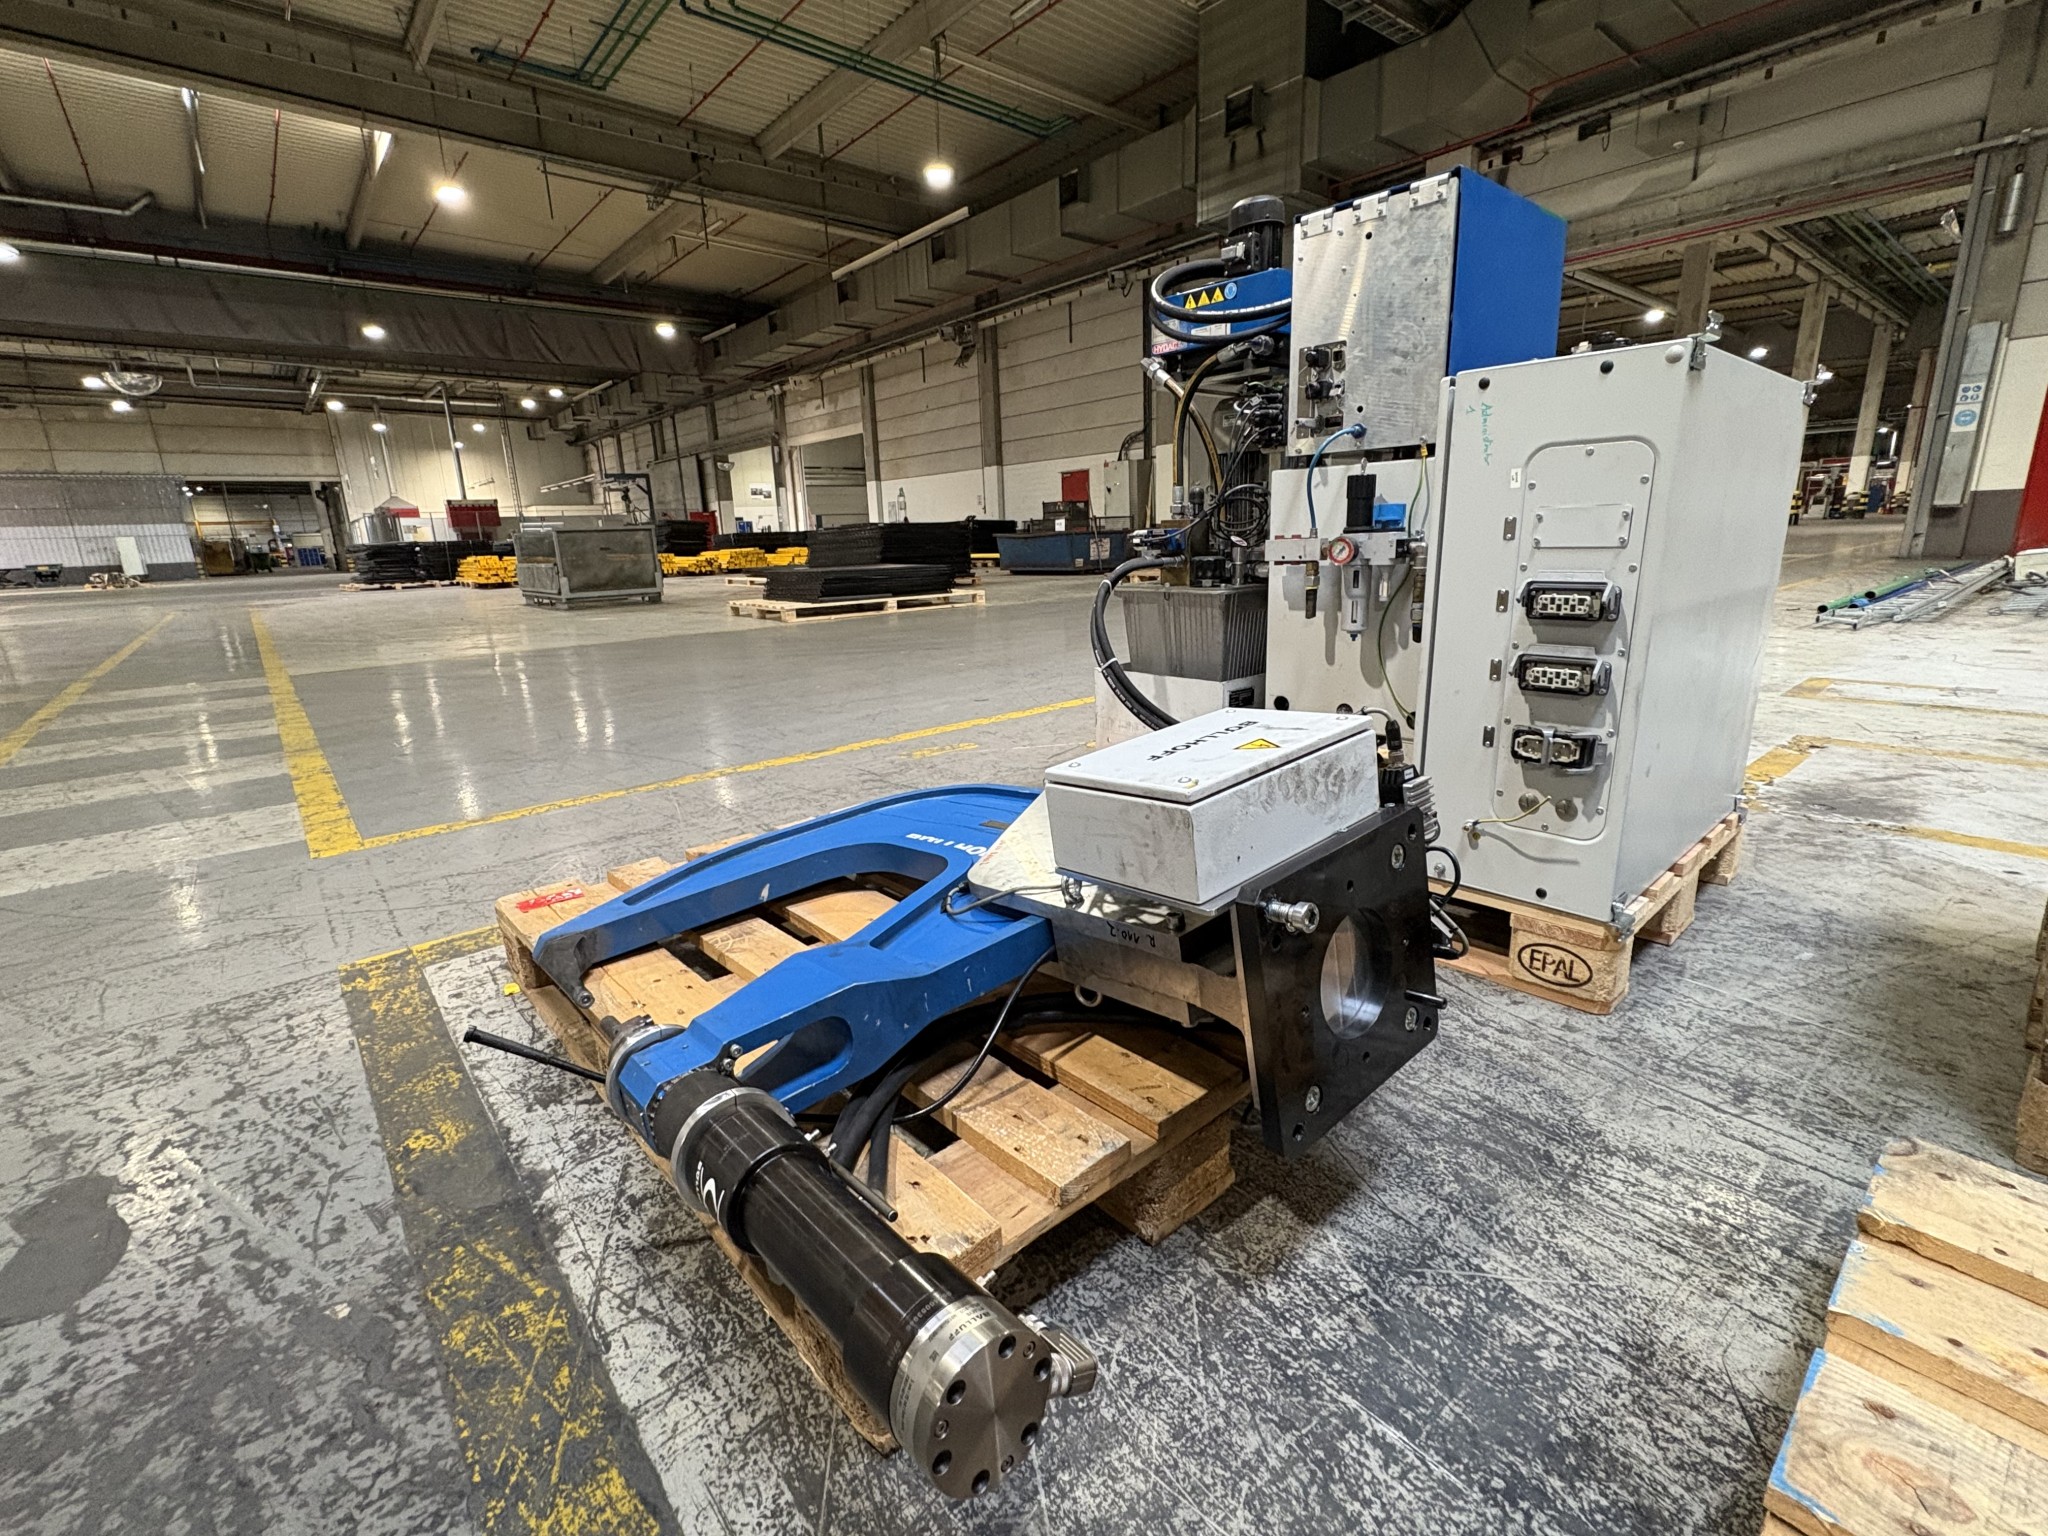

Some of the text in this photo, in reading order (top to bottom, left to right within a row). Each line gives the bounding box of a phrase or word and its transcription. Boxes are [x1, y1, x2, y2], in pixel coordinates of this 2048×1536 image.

[1106, 920, 1156, 948] R 110.2
[1528, 948, 1581, 983] EPAL
[949, 1310, 992, 1341] BALLUFF
